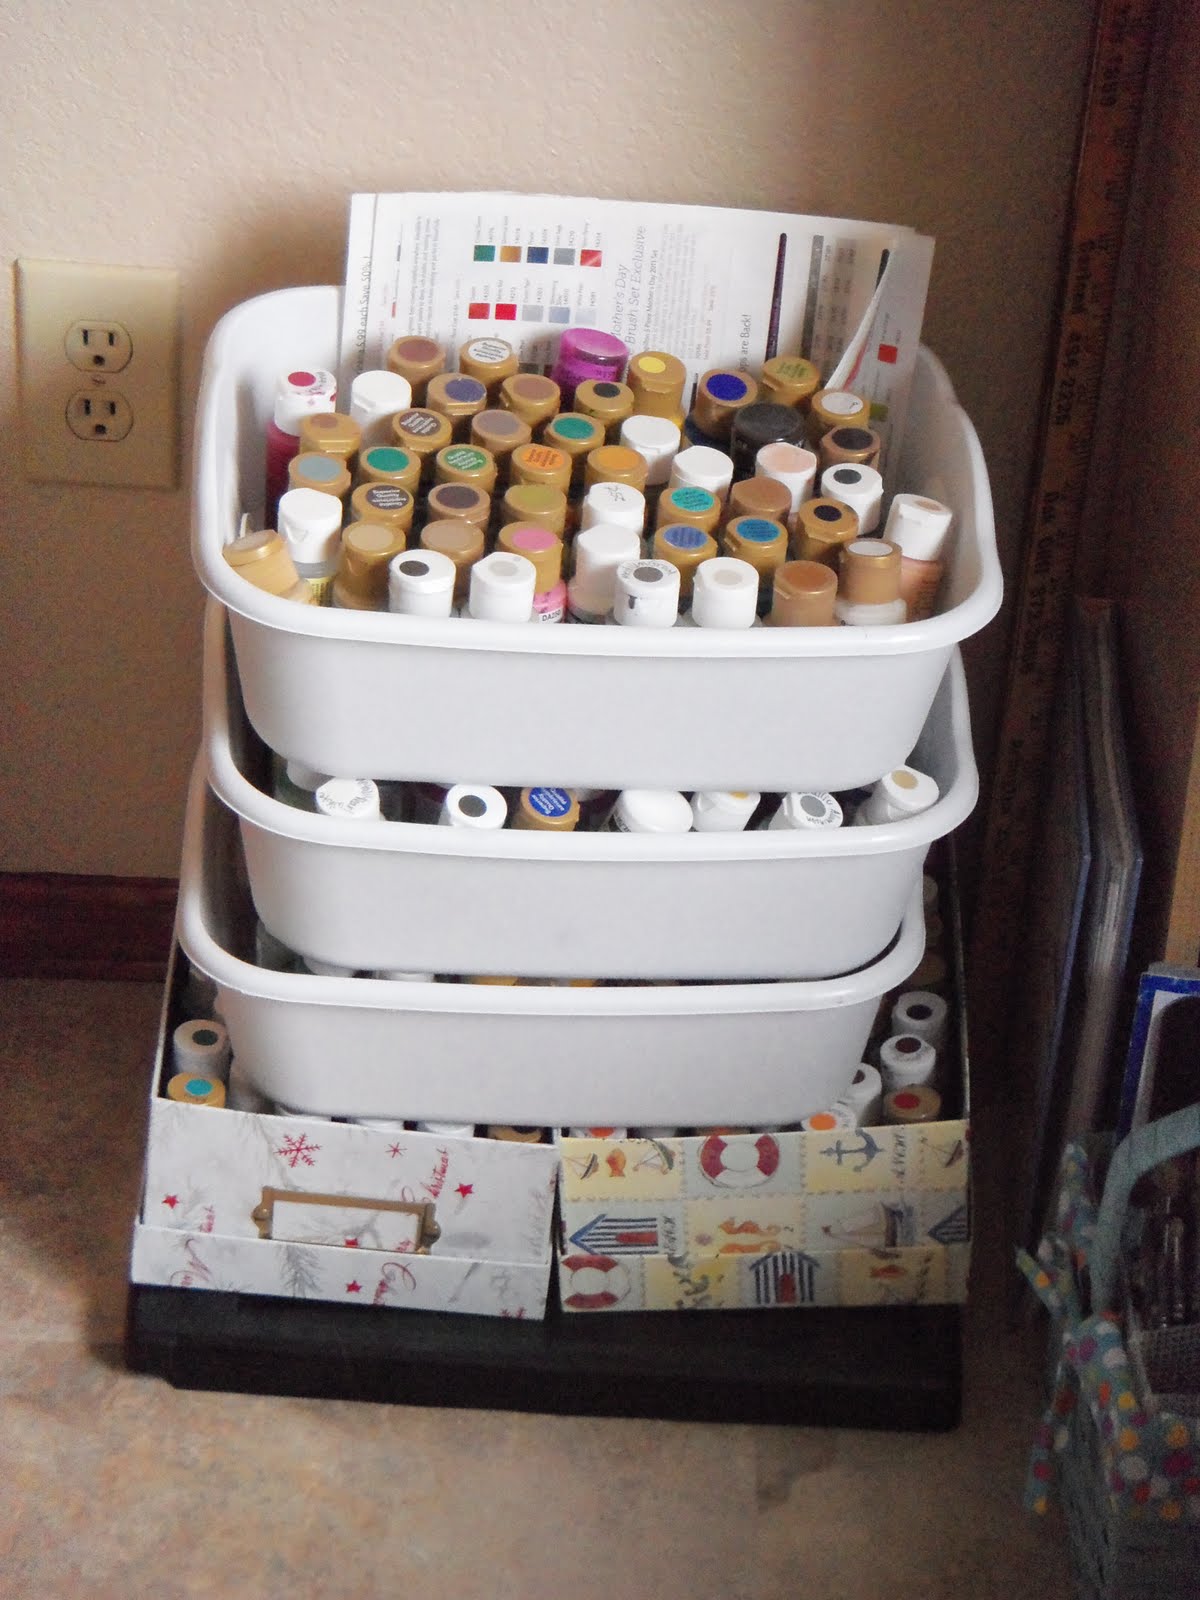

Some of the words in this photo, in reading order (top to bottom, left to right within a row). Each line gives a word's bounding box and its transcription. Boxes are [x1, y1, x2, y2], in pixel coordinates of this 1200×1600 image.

[630, 225, 647, 284] Exclusive
[615, 264, 630, 289] Day
[629, 286, 641, 307] Set
[610, 289, 625, 336] other's
[624, 309, 638, 345] Brush
[740, 314, 751, 338] Back!
[741, 340, 750, 354] are
